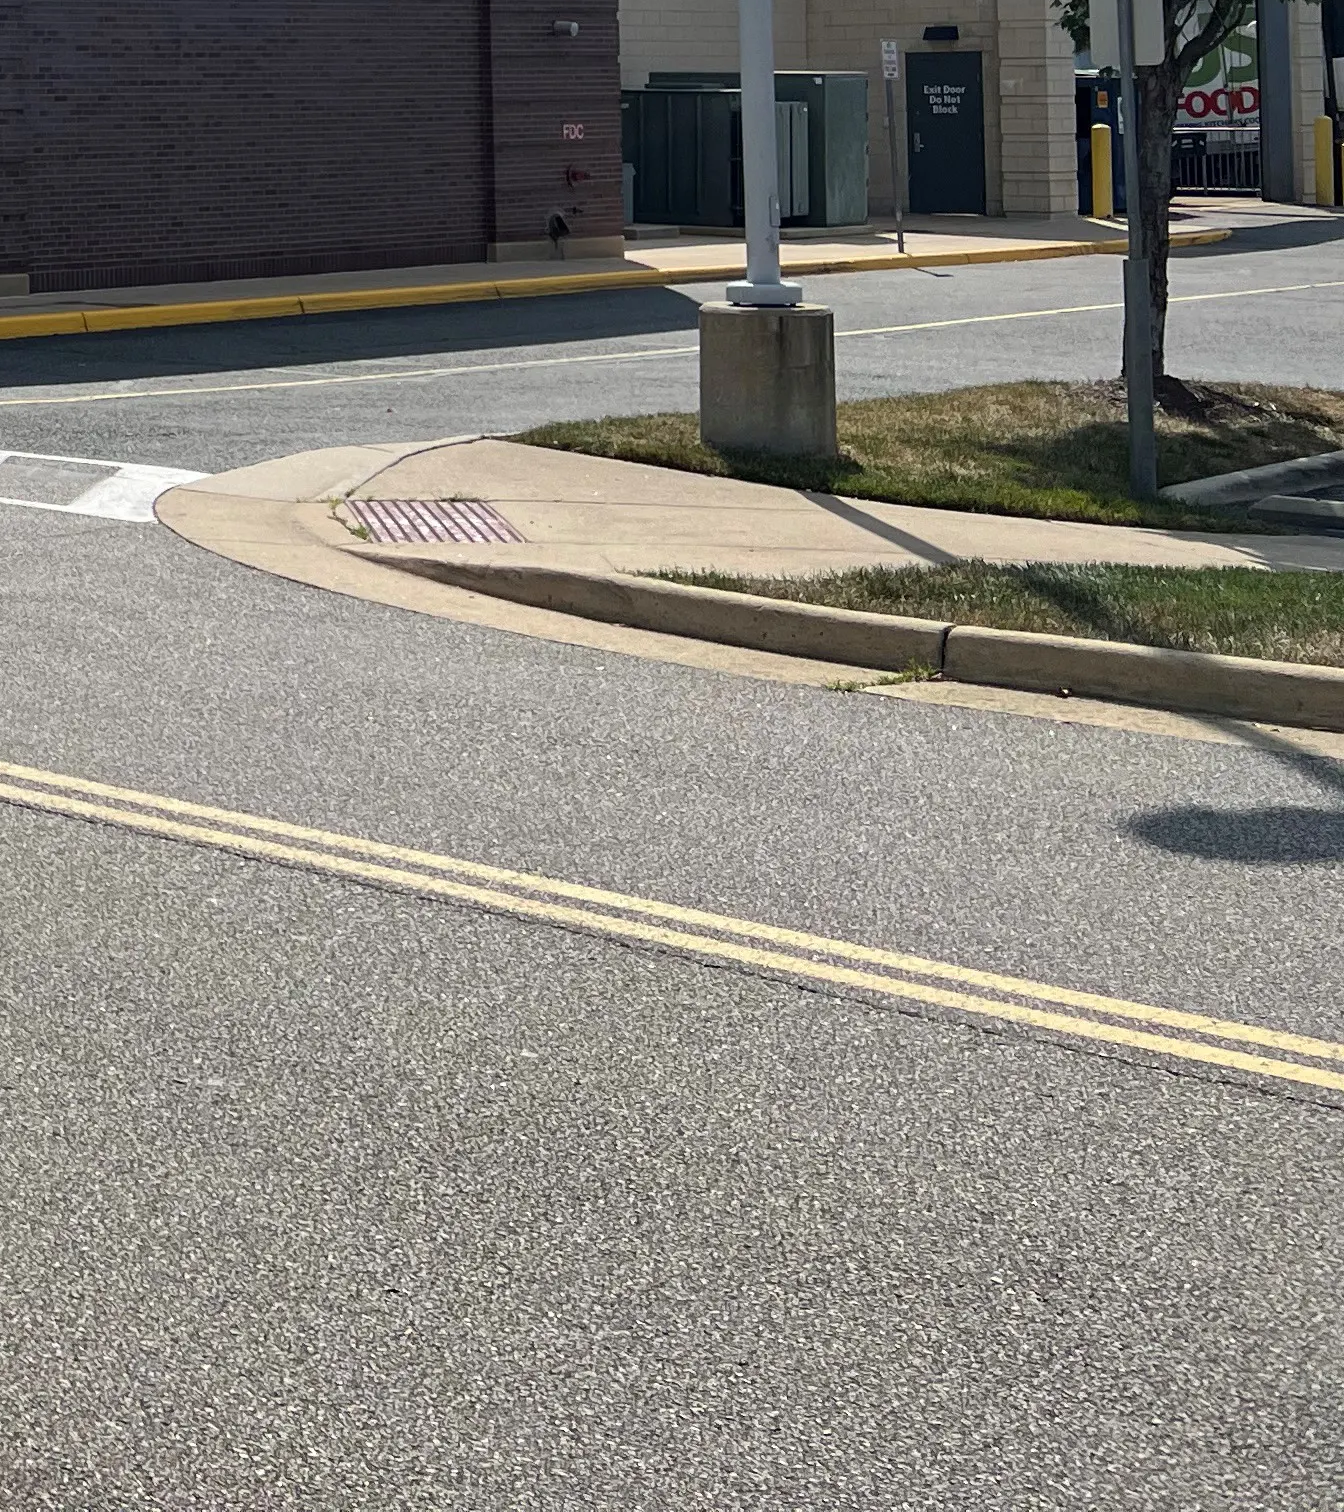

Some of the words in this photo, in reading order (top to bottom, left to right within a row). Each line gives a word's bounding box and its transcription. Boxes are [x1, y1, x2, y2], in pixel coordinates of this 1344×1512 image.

[923, 85, 942, 95] Exit
[943, 85, 966, 95] Door
[929, 95, 942, 105] Do
[944, 95, 961, 105] Not
[1178, 86, 1260, 119] OOD
[932, 104, 959, 115] Block
[563, 123, 584, 140] FDC
